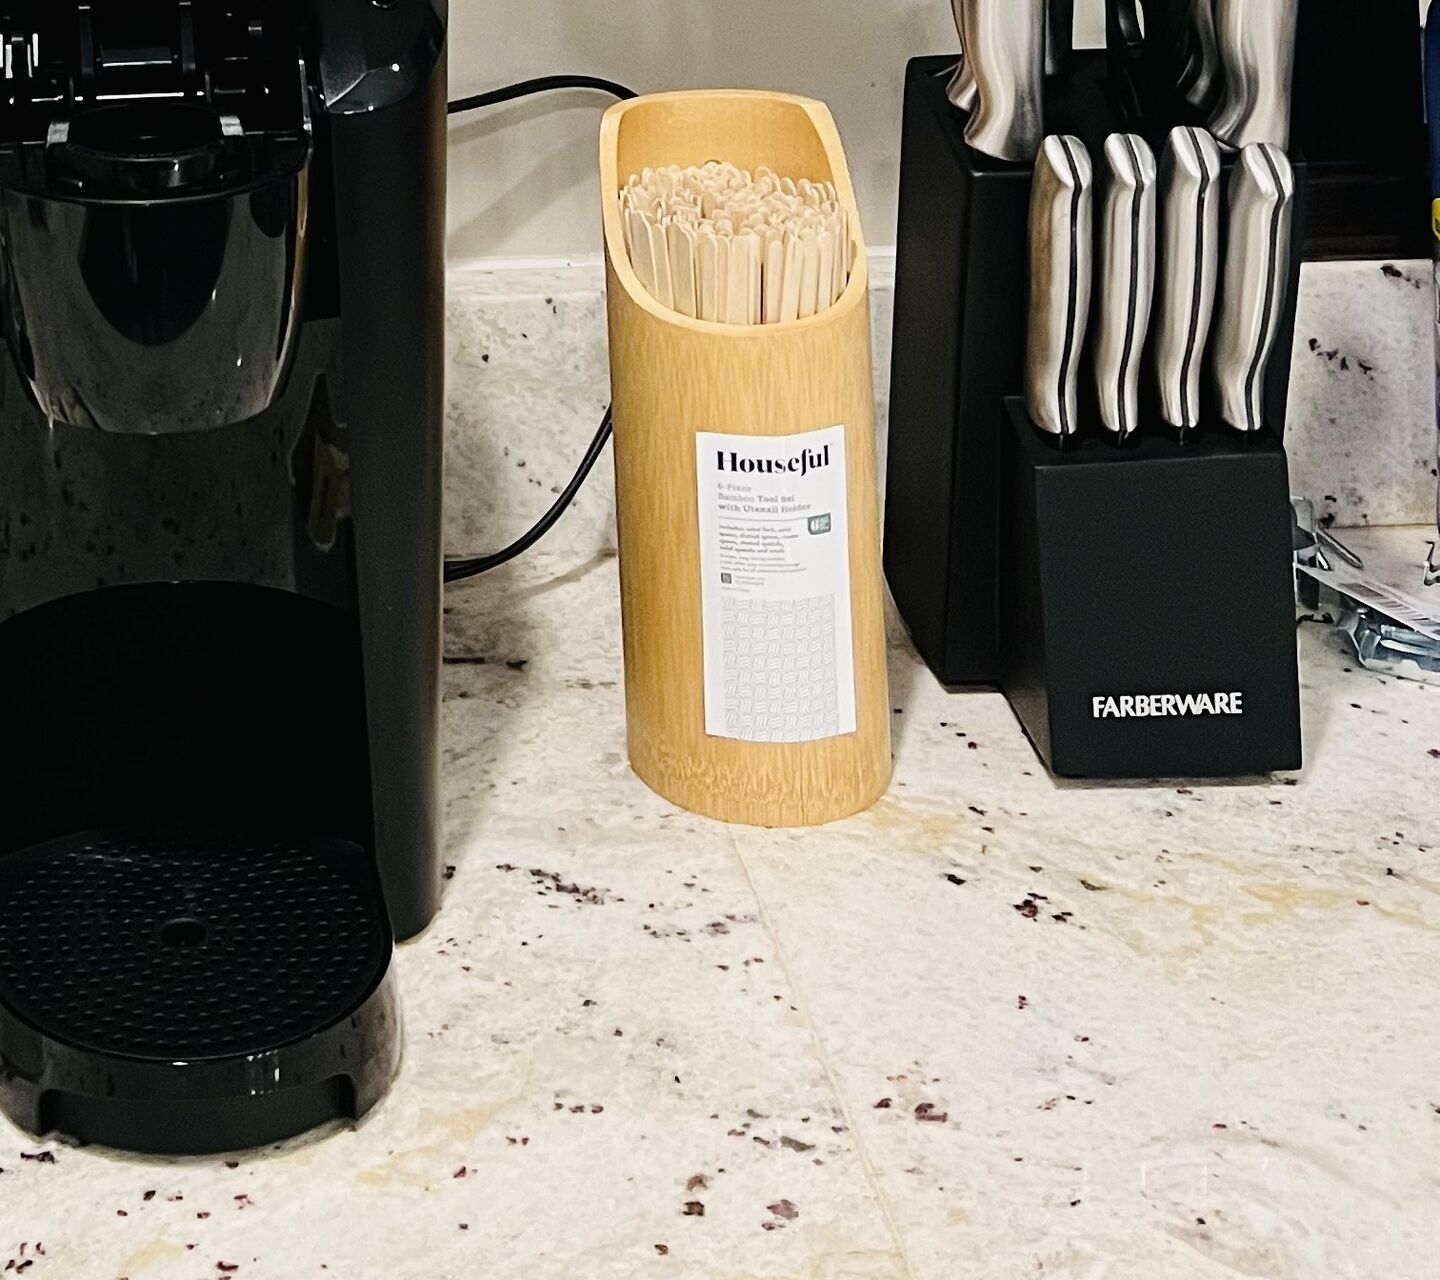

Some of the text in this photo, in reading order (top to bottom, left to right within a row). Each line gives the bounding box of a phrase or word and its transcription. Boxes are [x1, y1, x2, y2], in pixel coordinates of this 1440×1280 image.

[716, 444, 830, 476] Houseful
[718, 503, 741, 512] with
[1092, 692, 1243, 718] FARBERWARE
